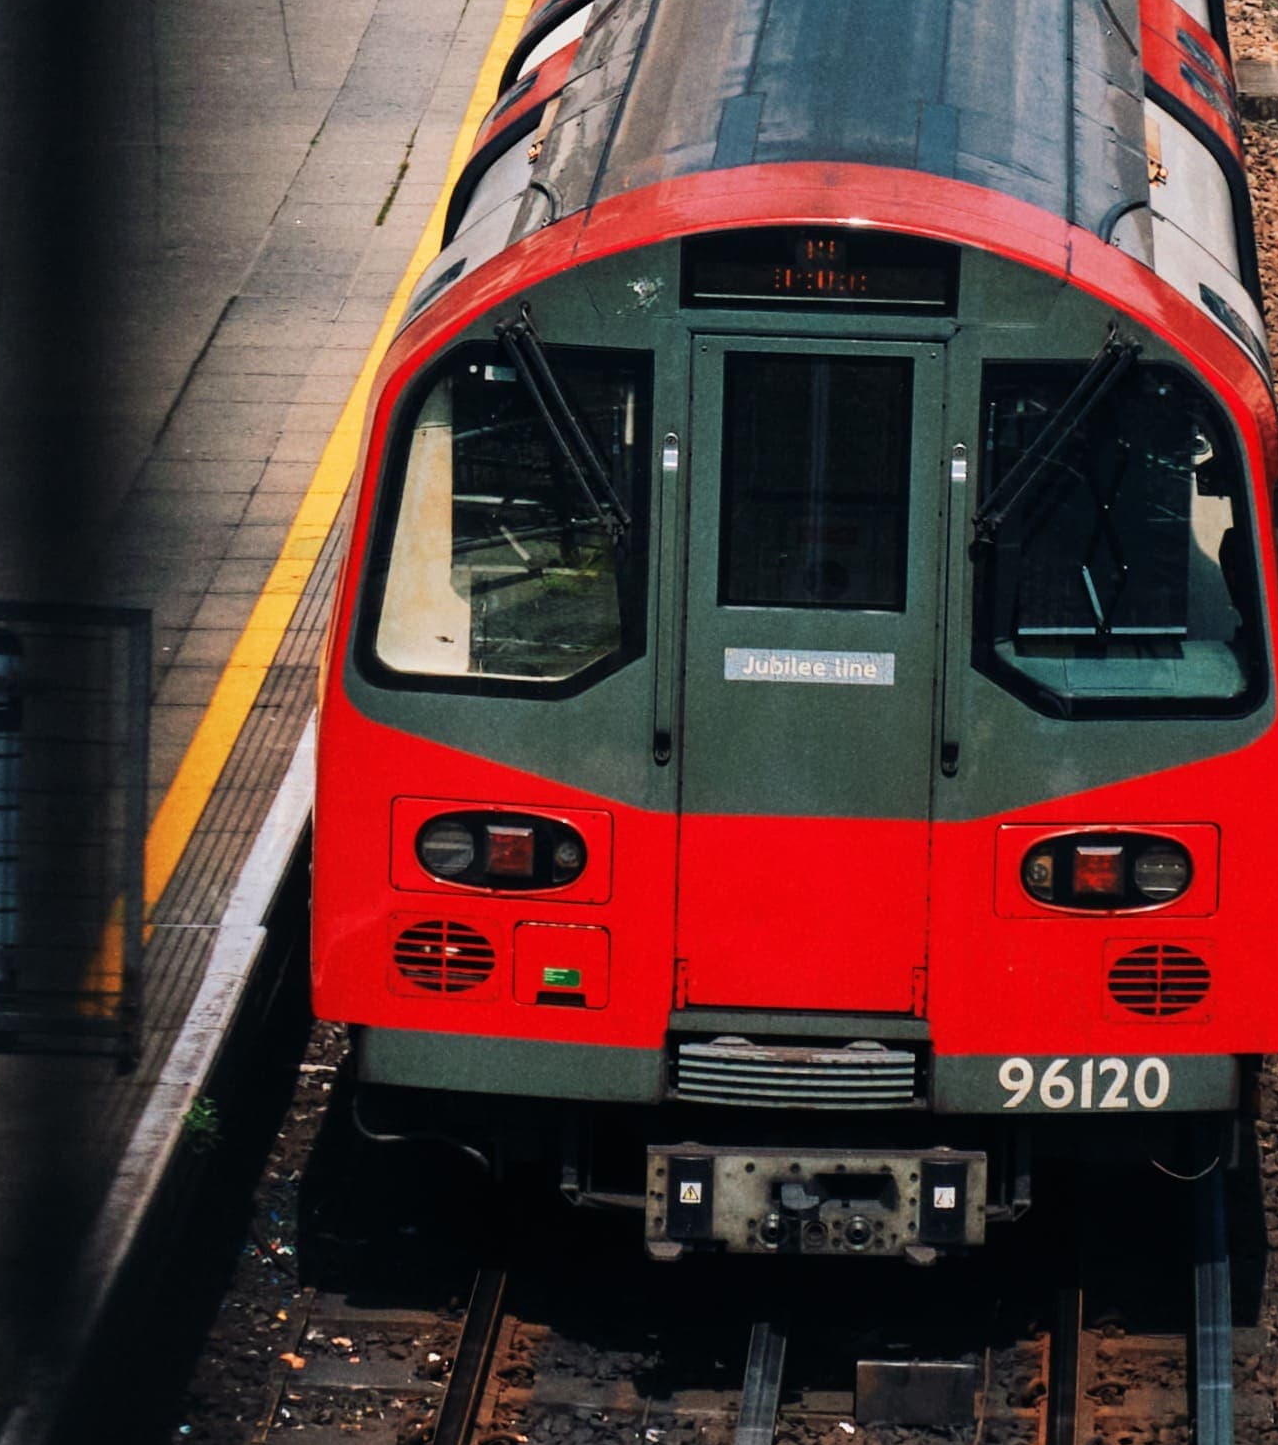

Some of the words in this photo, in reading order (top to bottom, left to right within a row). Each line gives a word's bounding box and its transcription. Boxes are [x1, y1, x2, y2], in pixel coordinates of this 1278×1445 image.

[742, 654, 828, 677] Jubilee
[835, 657, 878, 679] line
[998, 1056, 1171, 1109] 96120
